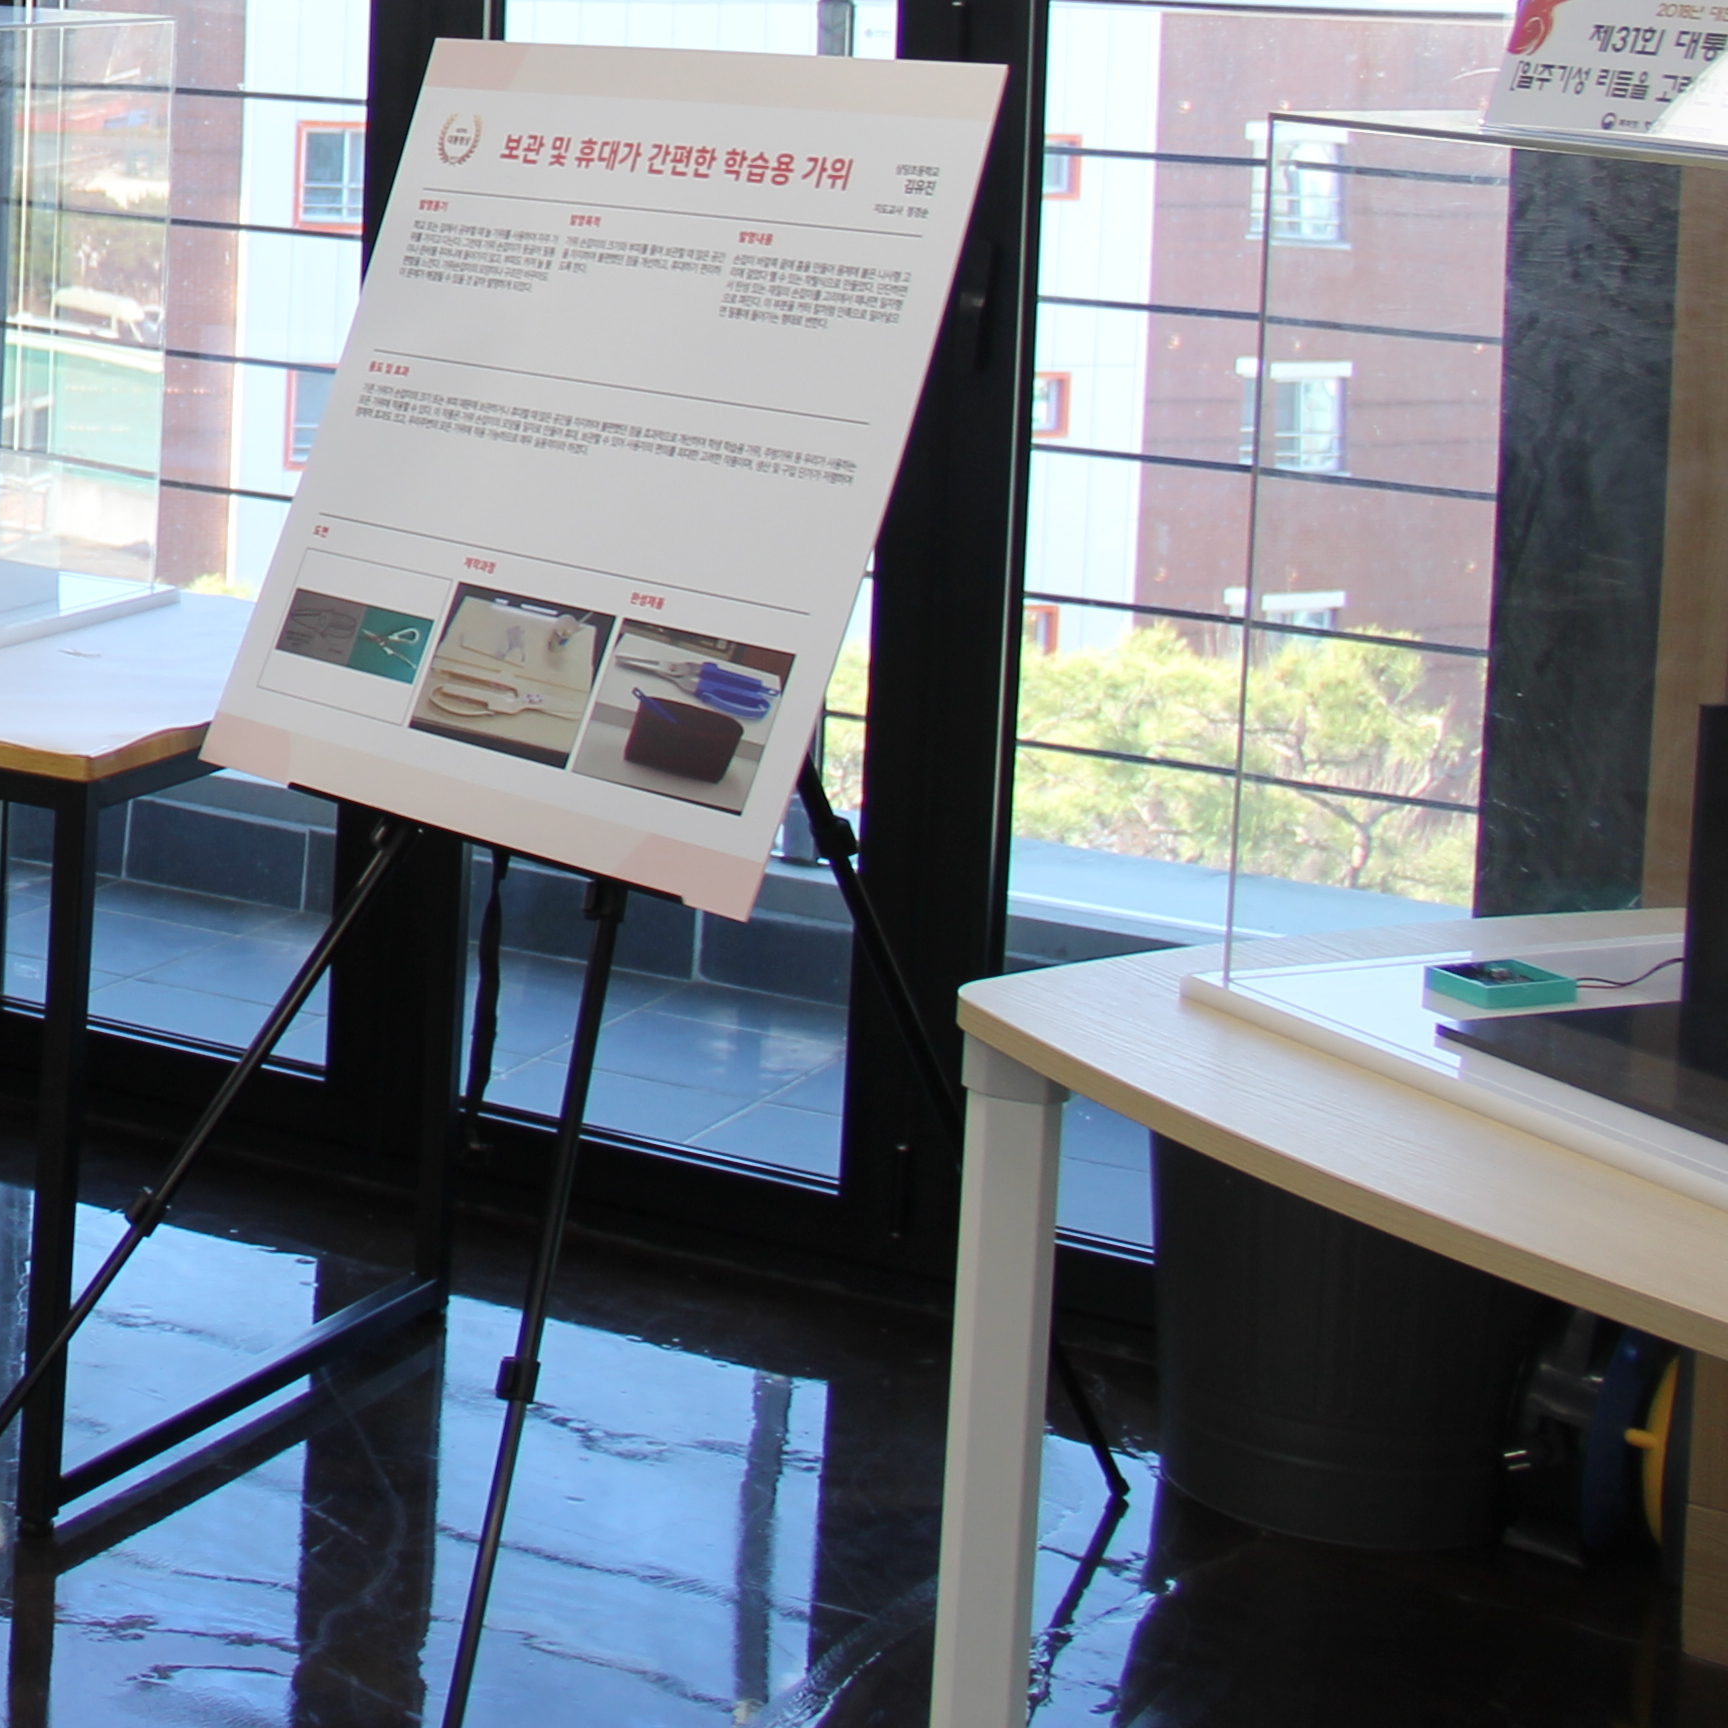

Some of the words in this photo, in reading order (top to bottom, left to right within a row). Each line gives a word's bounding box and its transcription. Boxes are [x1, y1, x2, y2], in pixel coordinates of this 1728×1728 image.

[1589, 24, 1665, 56] 제31회
[1595, 69, 1649, 100] 리듬을
[497, 132, 547, 166] 보관
[545, 135, 573, 168] 및
[571, 137, 645, 174] 휴대가
[642, 143, 721, 180] 간편한
[717, 148, 800, 187] 학습용
[797, 154, 857, 192] 가위
[902, 178, 937, 196] 김유진
[737, 230, 775, 245] 발명내용
